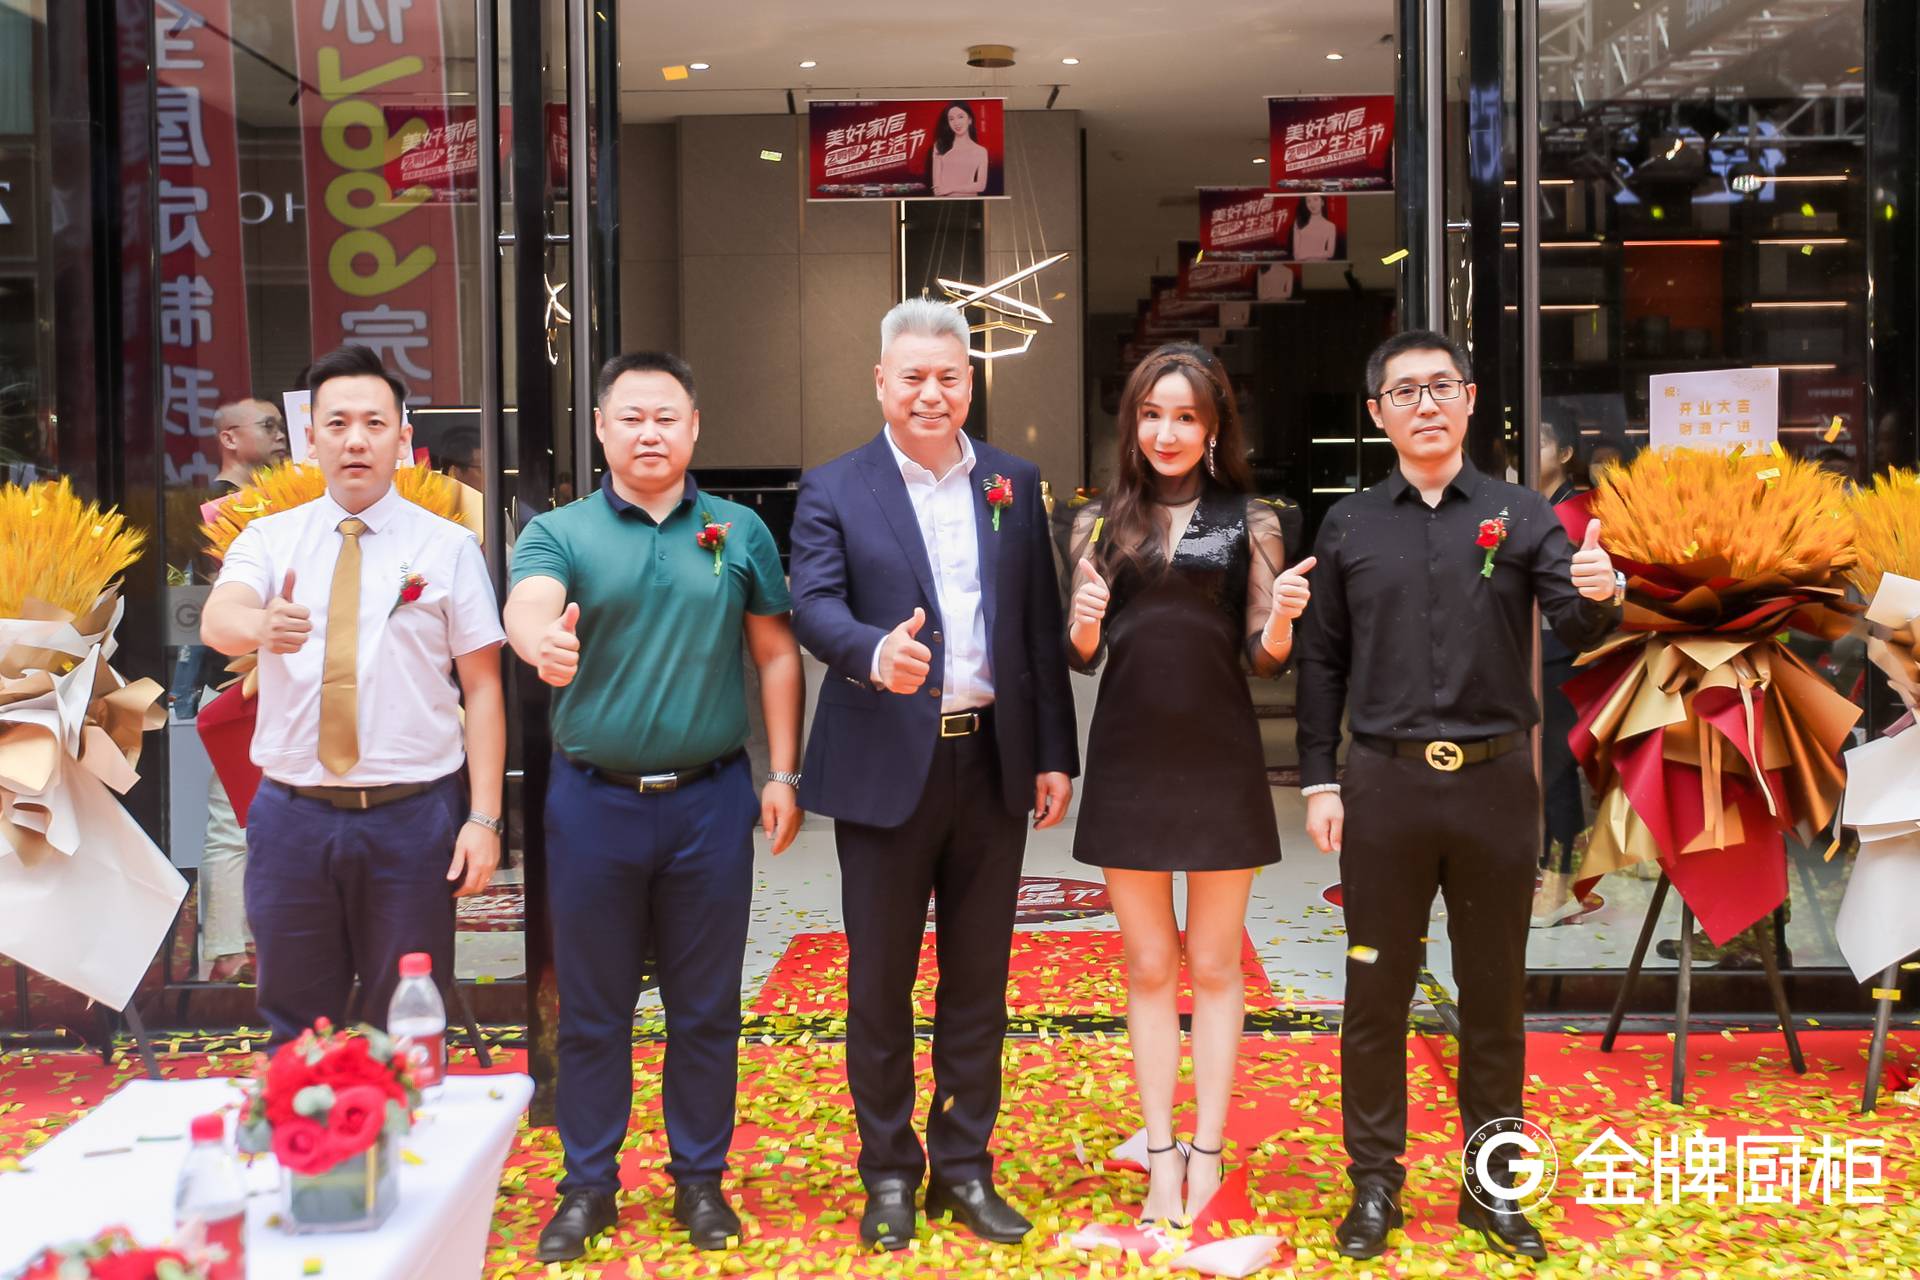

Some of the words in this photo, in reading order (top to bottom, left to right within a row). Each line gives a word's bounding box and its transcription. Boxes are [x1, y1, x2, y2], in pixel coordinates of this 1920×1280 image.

[825, 112, 908, 150] 美好家居
[1285, 107, 1366, 145] 美好家居
[1328, 122, 1385, 154] 生活节
[869, 128, 926, 159] 生活节
[1680, 400, 1750, 416] 开业大吉
[1680, 420, 1751, 436] 财源广进
